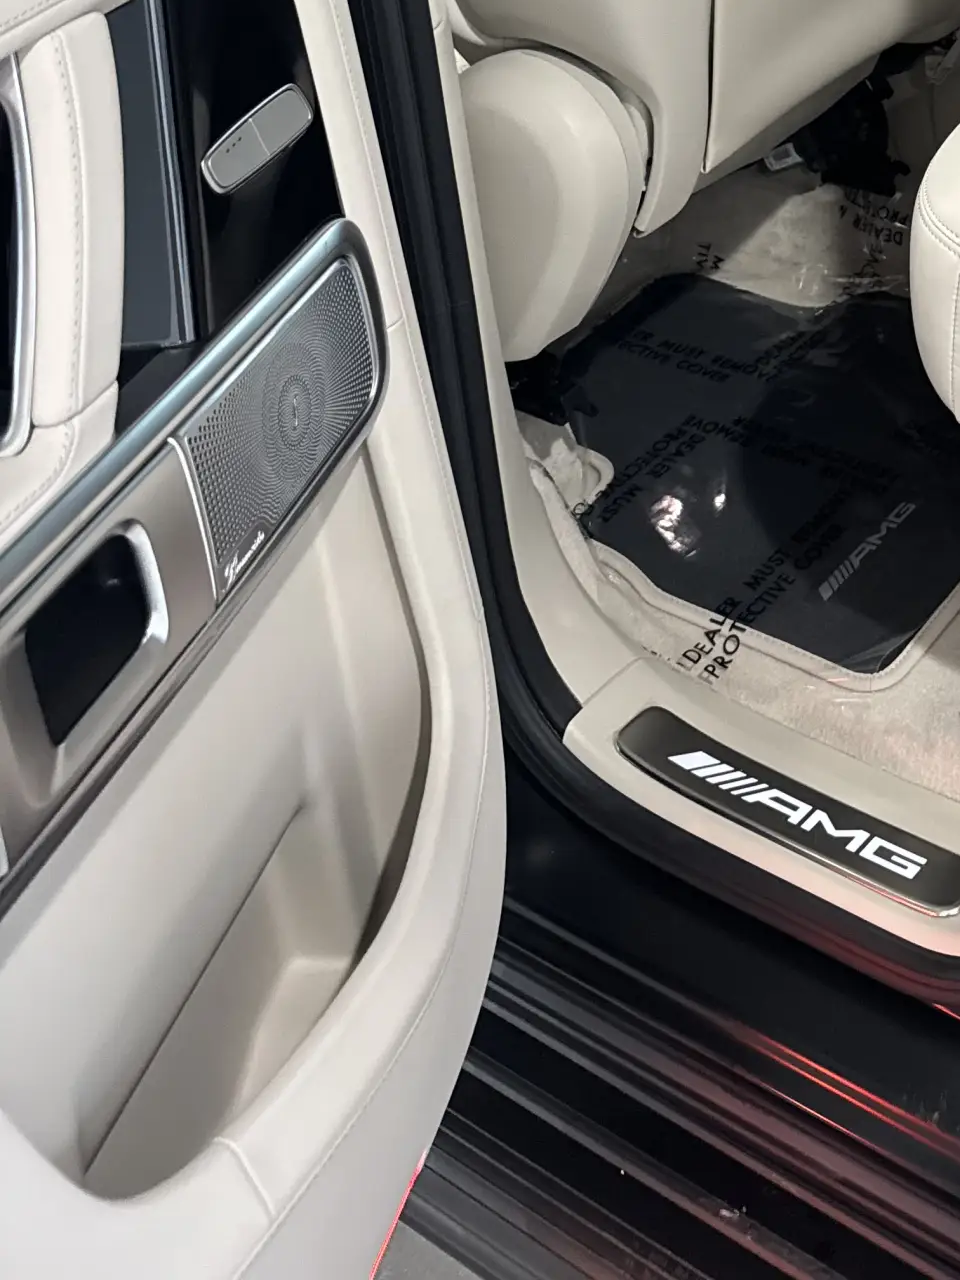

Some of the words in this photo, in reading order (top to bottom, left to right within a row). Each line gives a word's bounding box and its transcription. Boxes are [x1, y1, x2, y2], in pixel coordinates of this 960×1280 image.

[682, 596, 742, 665] DEALER
[742, 548, 792, 592] MUST
[703, 572, 796, 679] PROTECTIVE
[738, 787, 928, 881] AMG
